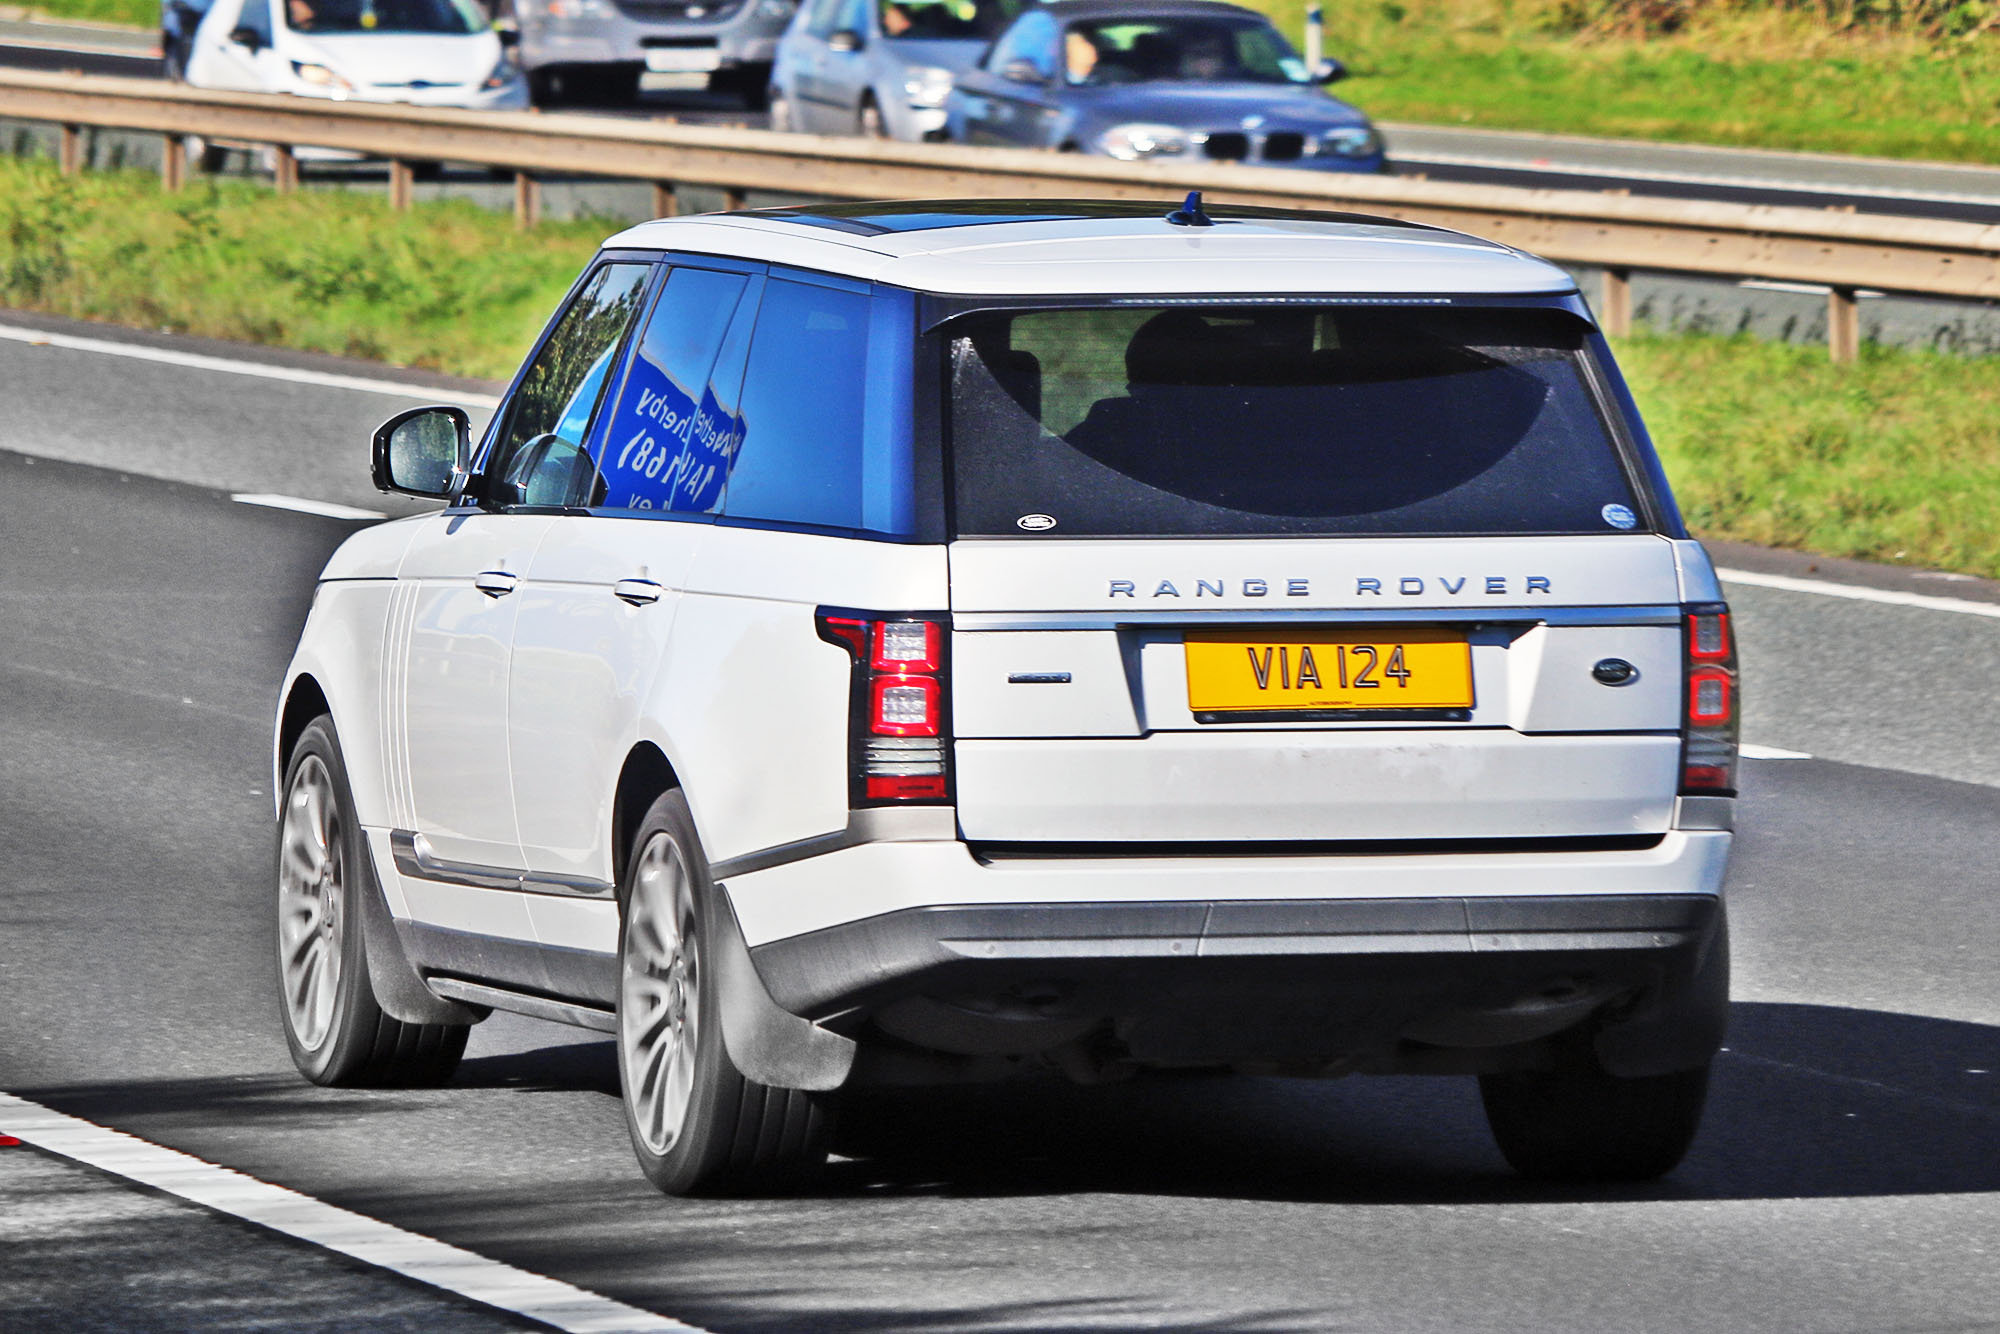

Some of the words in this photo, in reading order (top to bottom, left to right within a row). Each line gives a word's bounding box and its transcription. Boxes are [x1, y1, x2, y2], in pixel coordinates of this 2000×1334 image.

[1108, 578, 1310, 597] RANGE
[1355, 576, 1552, 595] ROVER
[1337, 644, 1412, 689] 124
